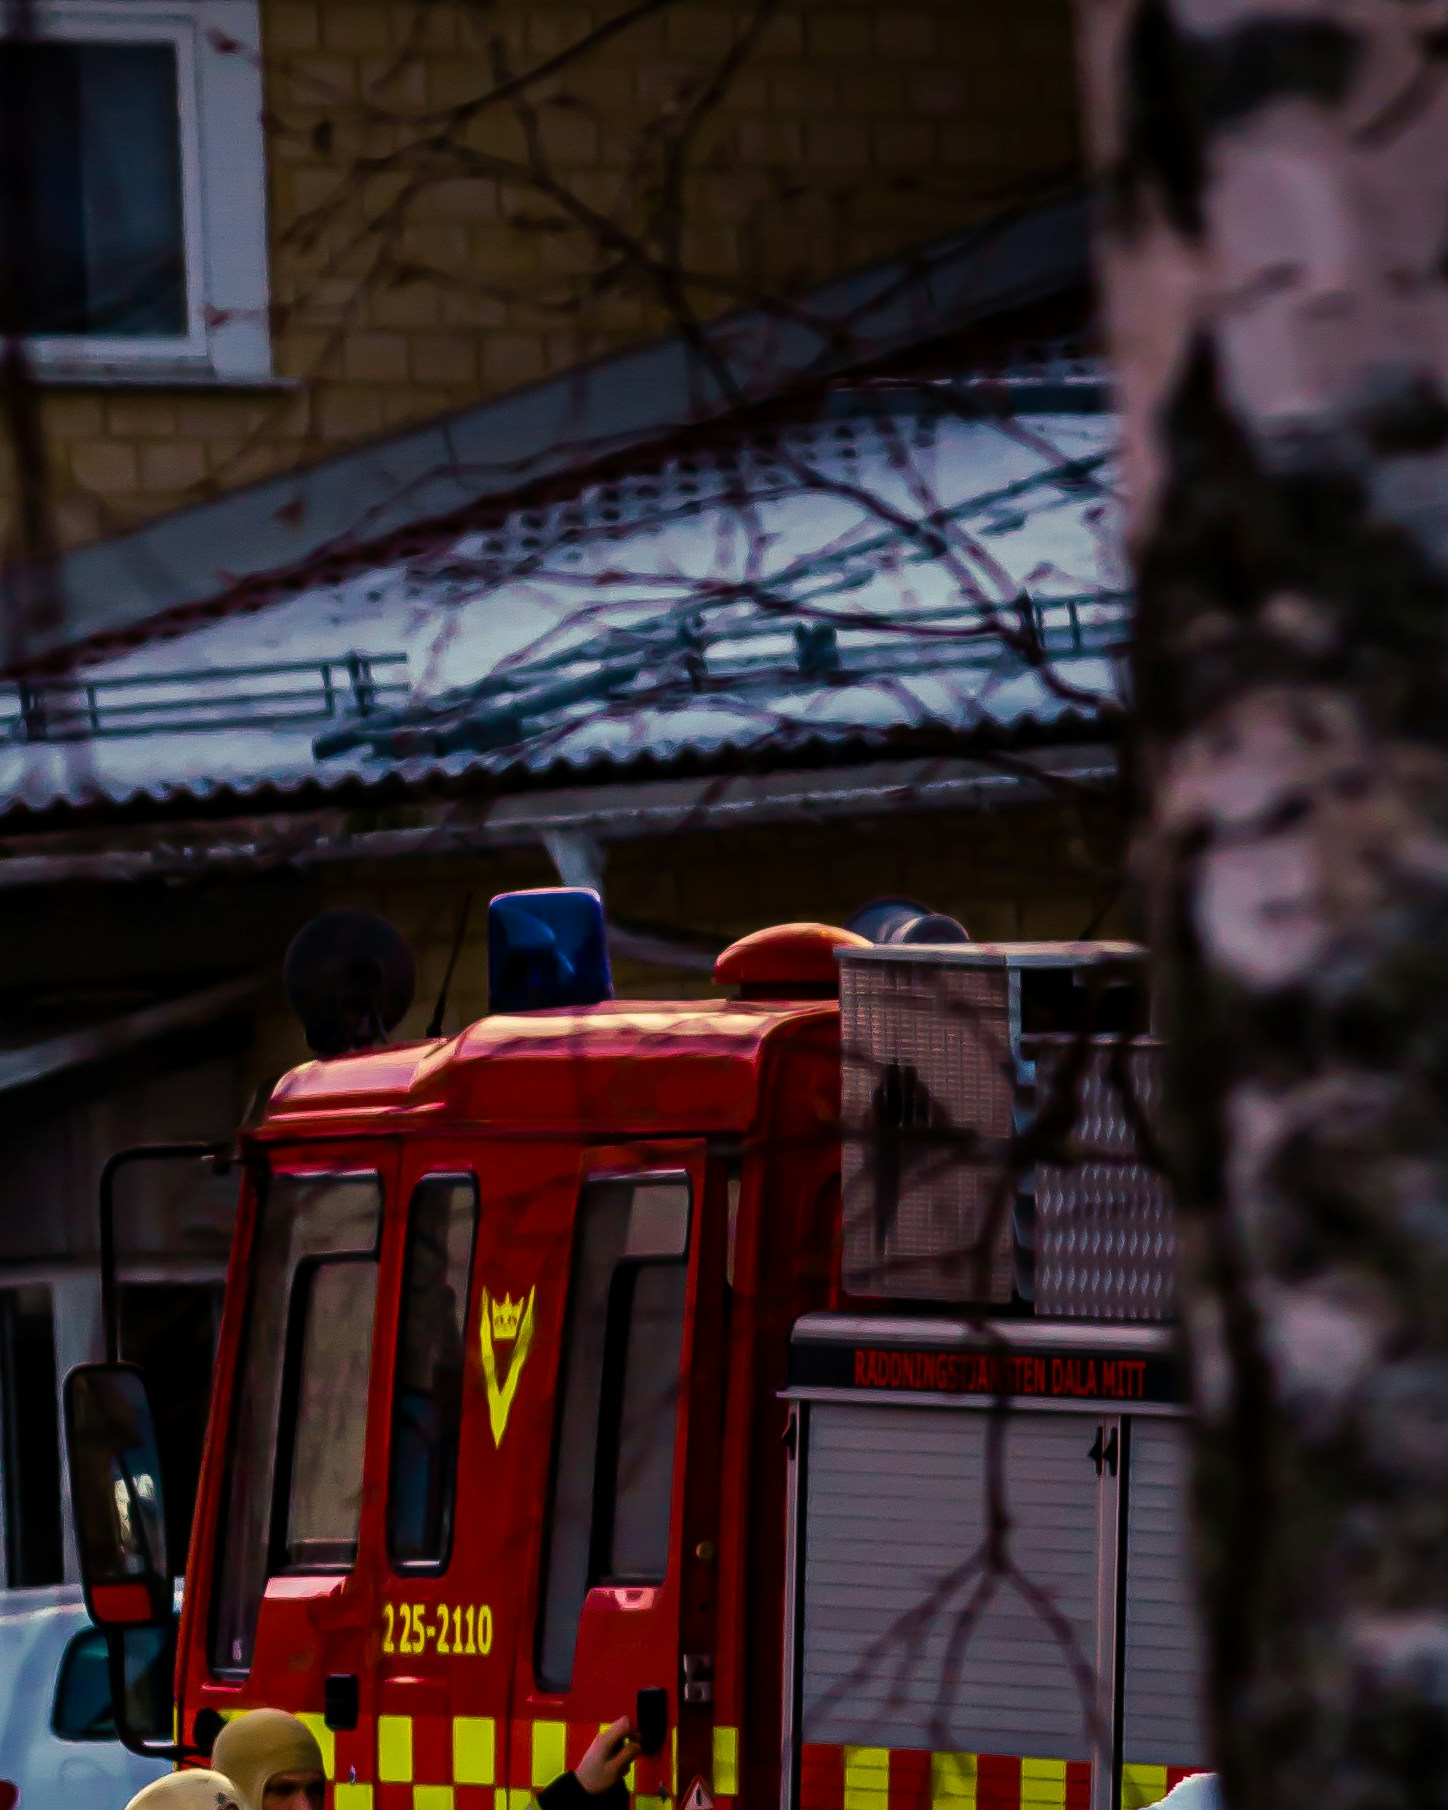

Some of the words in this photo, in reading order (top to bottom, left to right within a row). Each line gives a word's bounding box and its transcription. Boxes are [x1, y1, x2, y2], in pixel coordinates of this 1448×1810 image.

[1051, 1356, 1098, 1396] DALA
[1102, 1359, 1147, 1398] MITT
[383, 1603, 494, 1655] 225-2110
